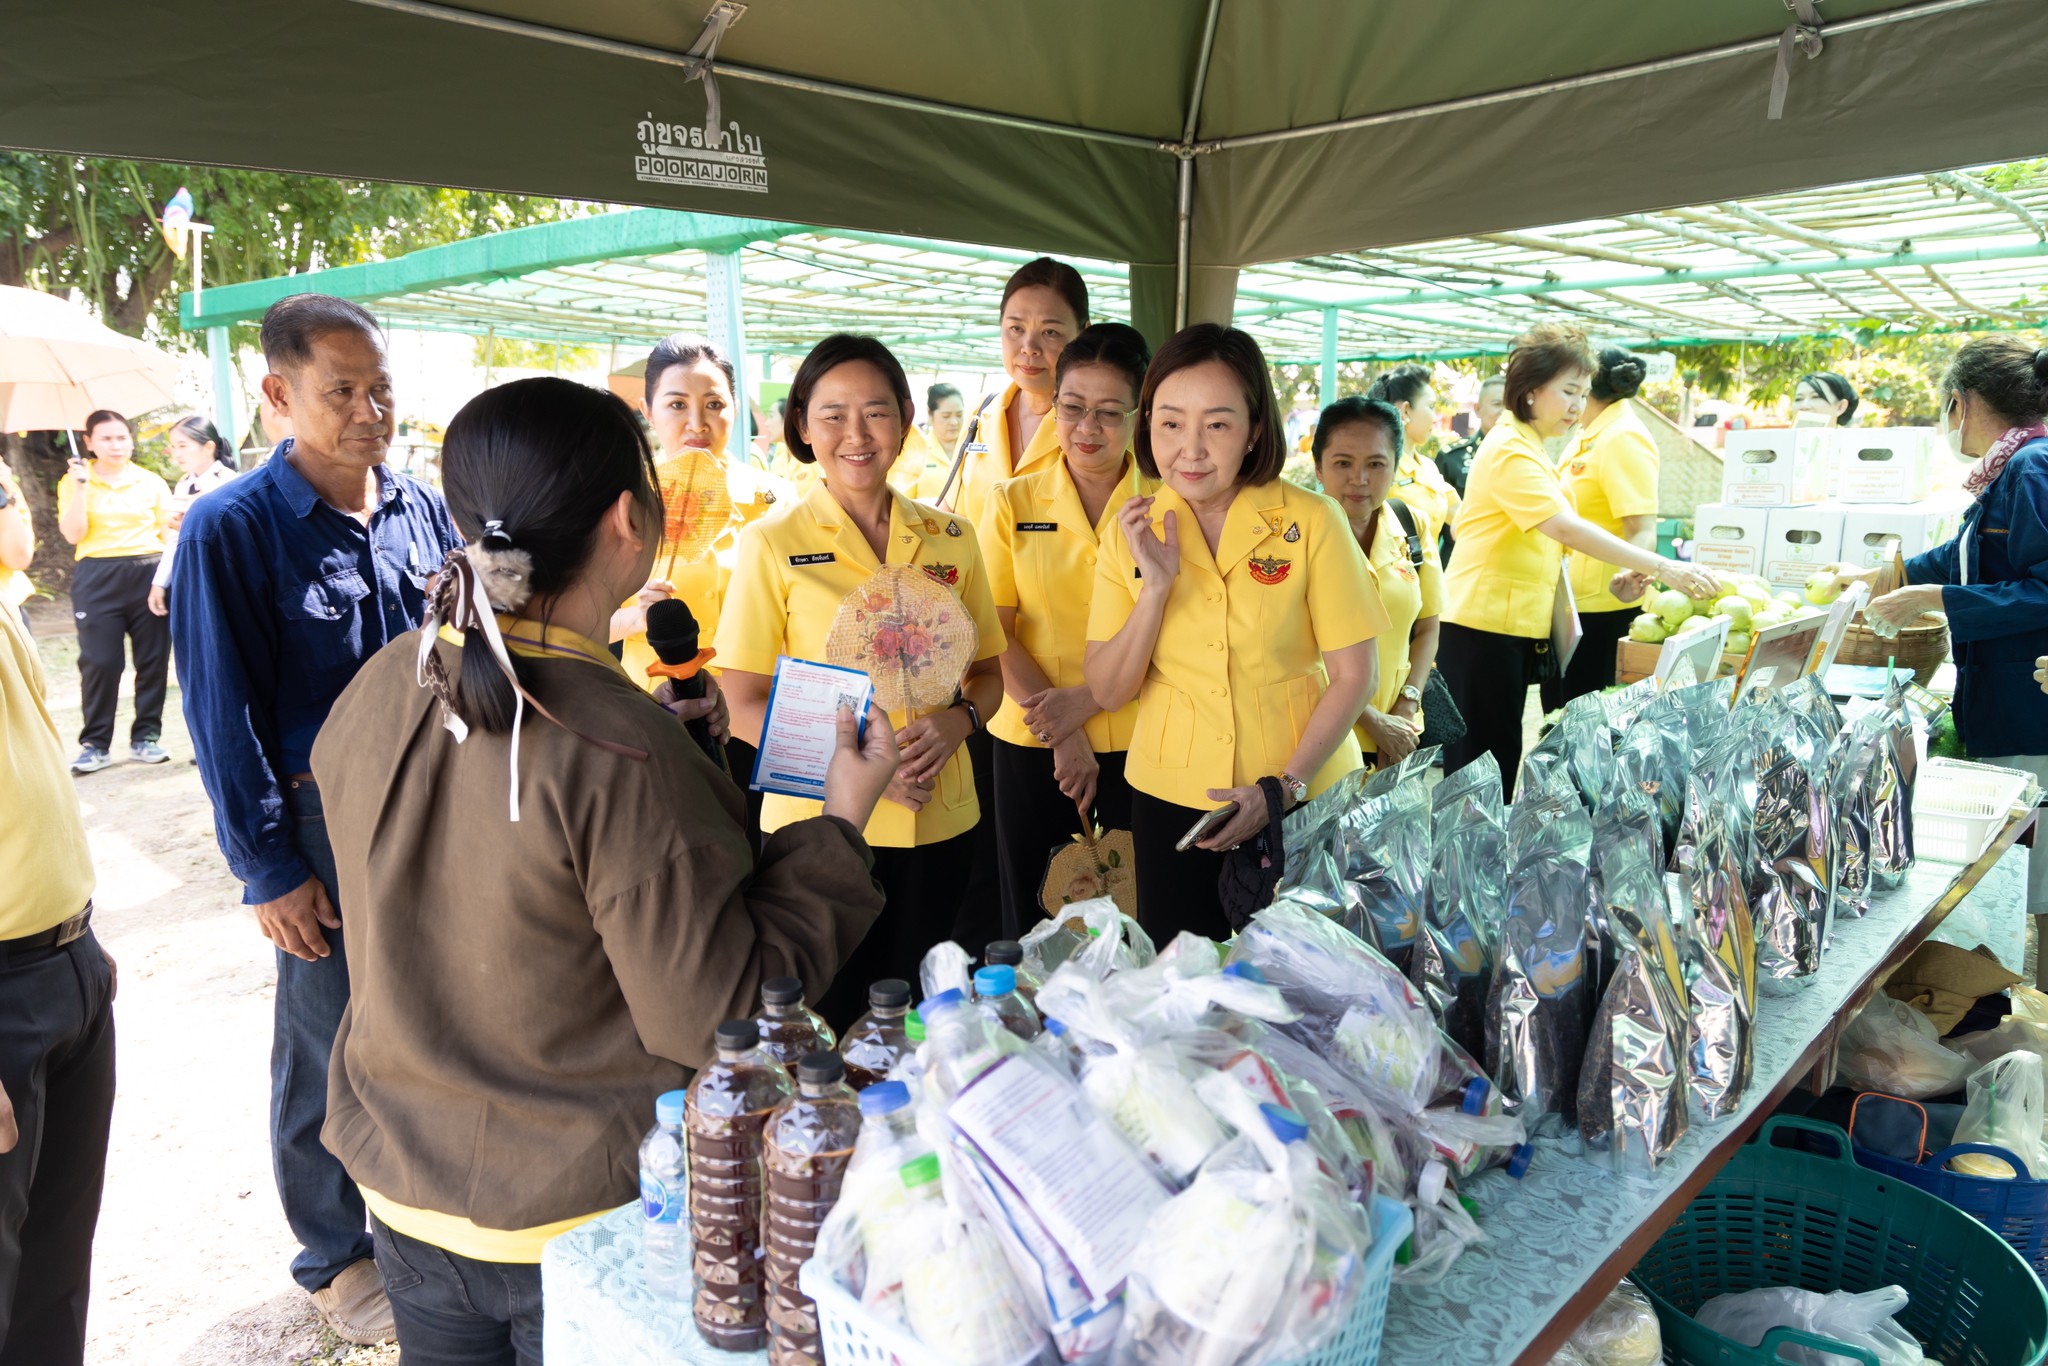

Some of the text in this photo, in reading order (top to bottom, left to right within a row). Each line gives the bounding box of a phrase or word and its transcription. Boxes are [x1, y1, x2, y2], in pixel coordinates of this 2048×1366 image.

[637, 112, 763, 156] ภู่ขจราใบ
[637, 158, 767, 185] POOKAJORN
[642, 1190, 665, 1205] STAL
